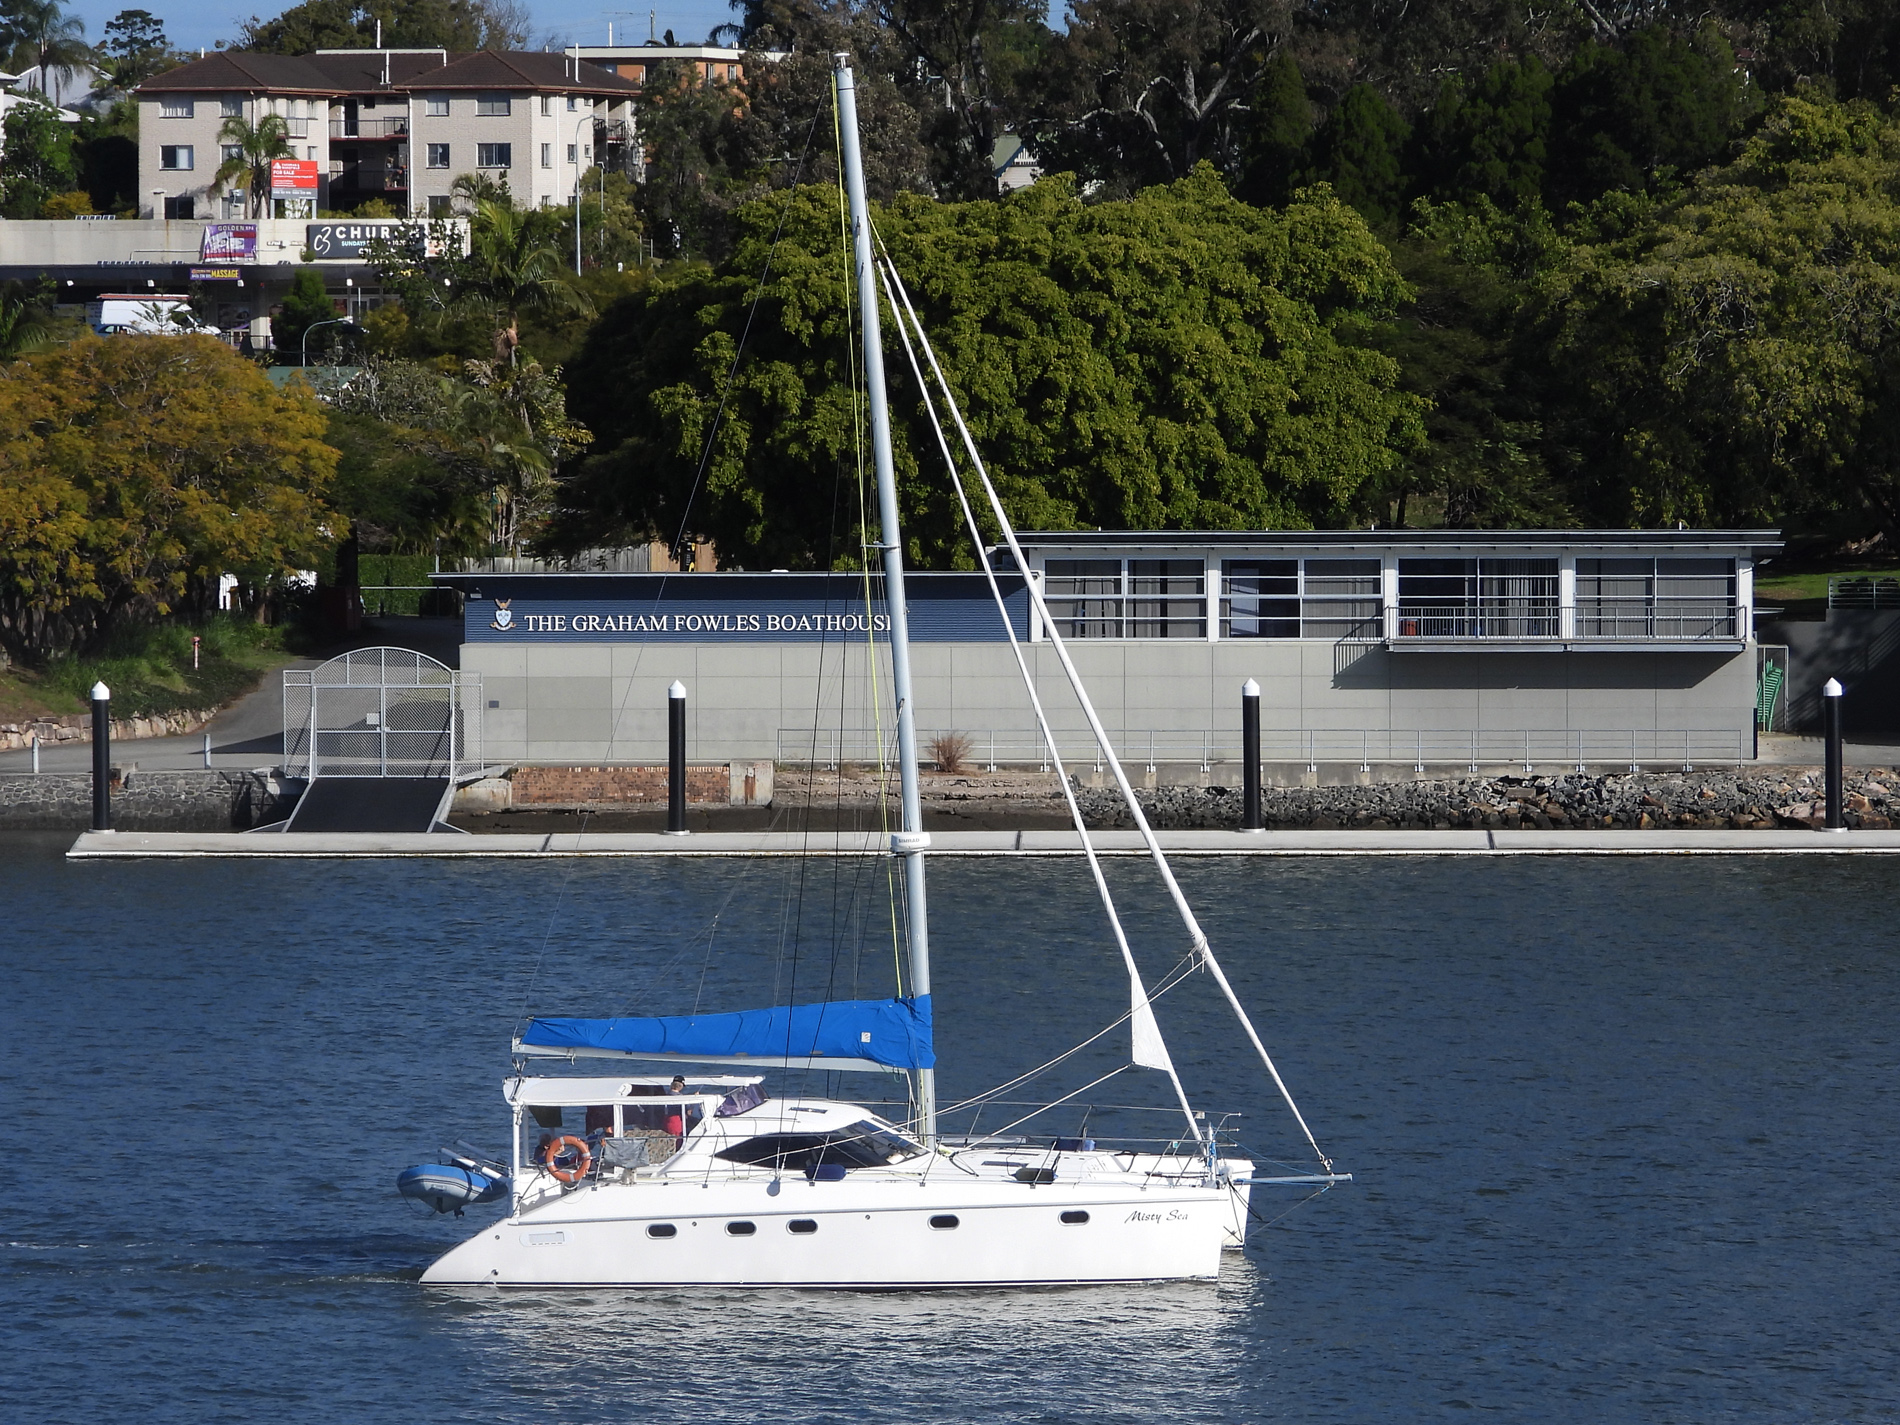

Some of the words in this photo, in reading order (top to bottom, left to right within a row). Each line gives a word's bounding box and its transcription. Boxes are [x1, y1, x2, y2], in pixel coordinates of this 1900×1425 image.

[335, 226, 420, 239] CHUR
[211, 269, 239, 278] MASSAGE
[524, 615, 566, 632] THE
[572, 615, 668, 632] GRAHAM
[673, 615, 760, 632] FOWLES
[1124, 1210, 1161, 1224] Misty
[1166, 1209, 1188, 1221] Sea
